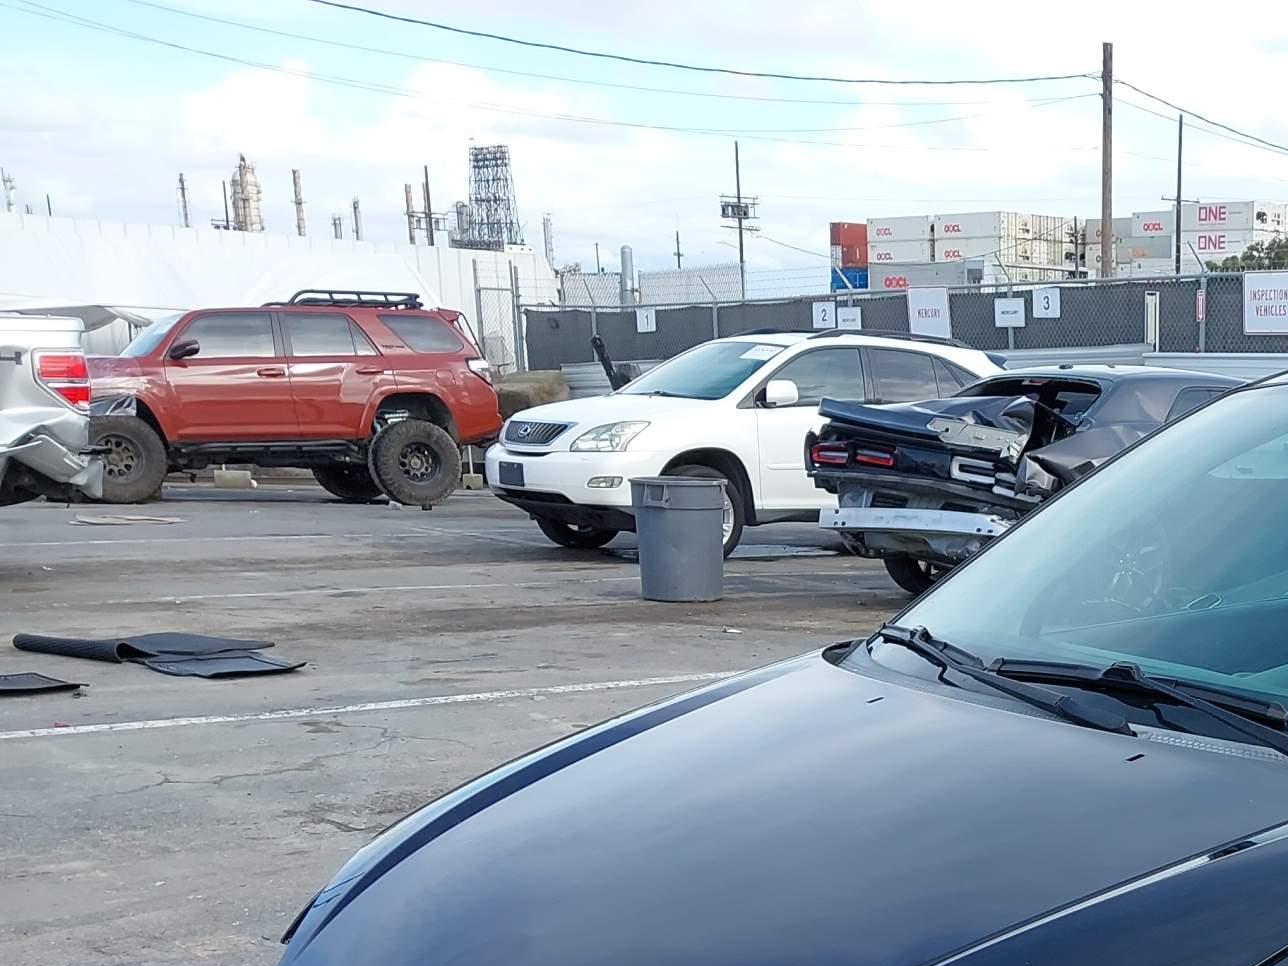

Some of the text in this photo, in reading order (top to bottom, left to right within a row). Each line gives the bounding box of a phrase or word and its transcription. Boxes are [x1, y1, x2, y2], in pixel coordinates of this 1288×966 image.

[1198, 206, 1227, 221] ONE
[876, 228, 892, 236] OOCL
[943, 224, 962, 233] OOCL
[1143, 222, 1163, 232] OOCL
[1198, 235, 1226, 250] ONE
[877, 252, 893, 261] OOCL
[944, 250, 961, 258] OOCL
[884, 276, 909, 288] OOCL
[1043, 296, 1050, 310] 3
[820, 308, 828, 322] 2
[917, 308, 941, 319] MERCURY
[1255, 304, 1287, 317] VEHICLES
